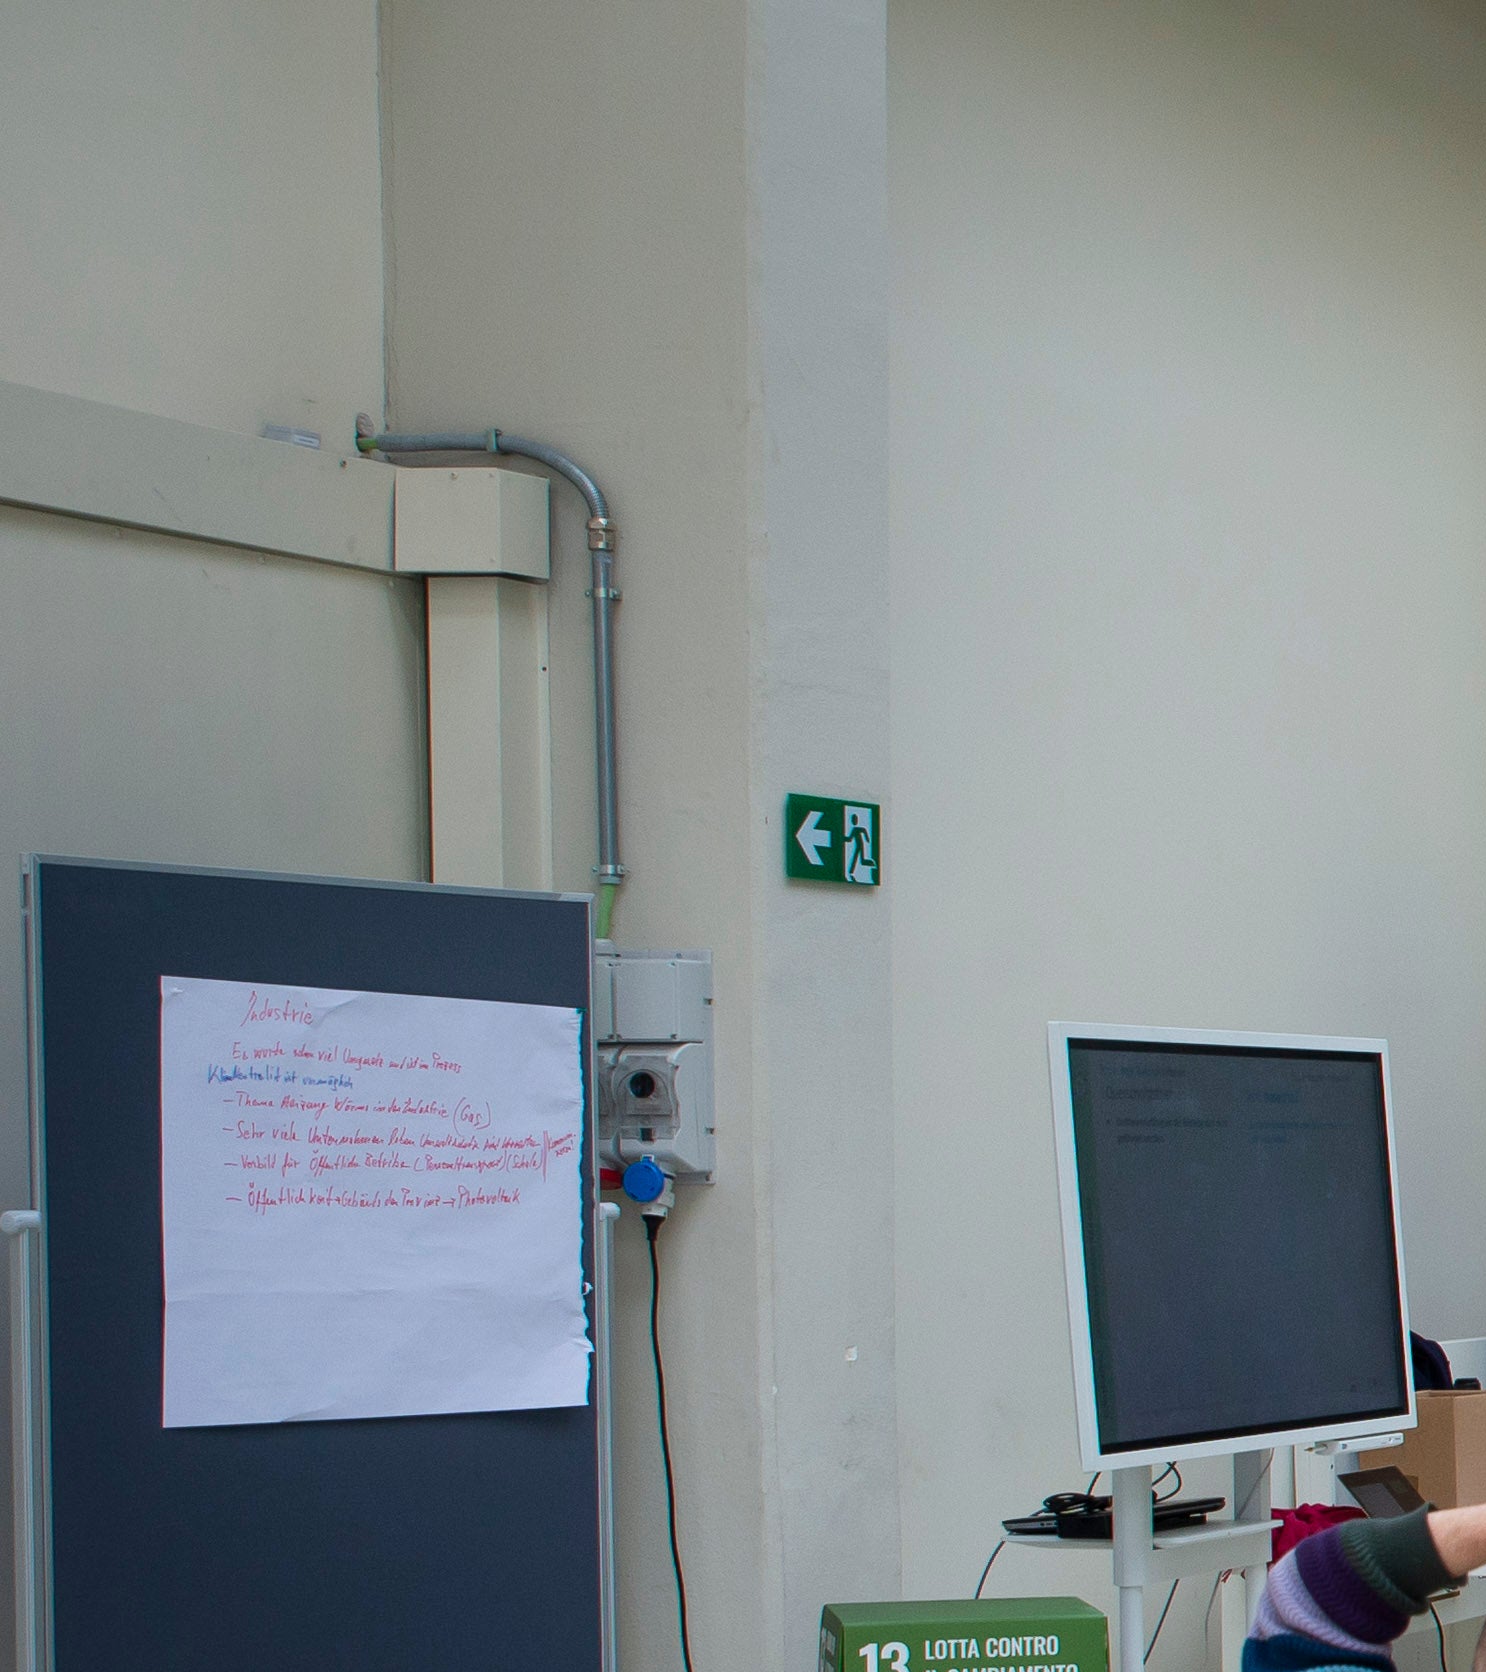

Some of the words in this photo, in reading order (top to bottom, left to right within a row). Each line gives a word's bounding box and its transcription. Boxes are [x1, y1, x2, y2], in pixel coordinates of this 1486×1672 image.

[240, 990, 313, 1027] Industrie
[318, 1045, 338, 1062] viel
[924, 1638, 980, 1660] LOTTA
[985, 1635, 1059, 1658] CONTRO
